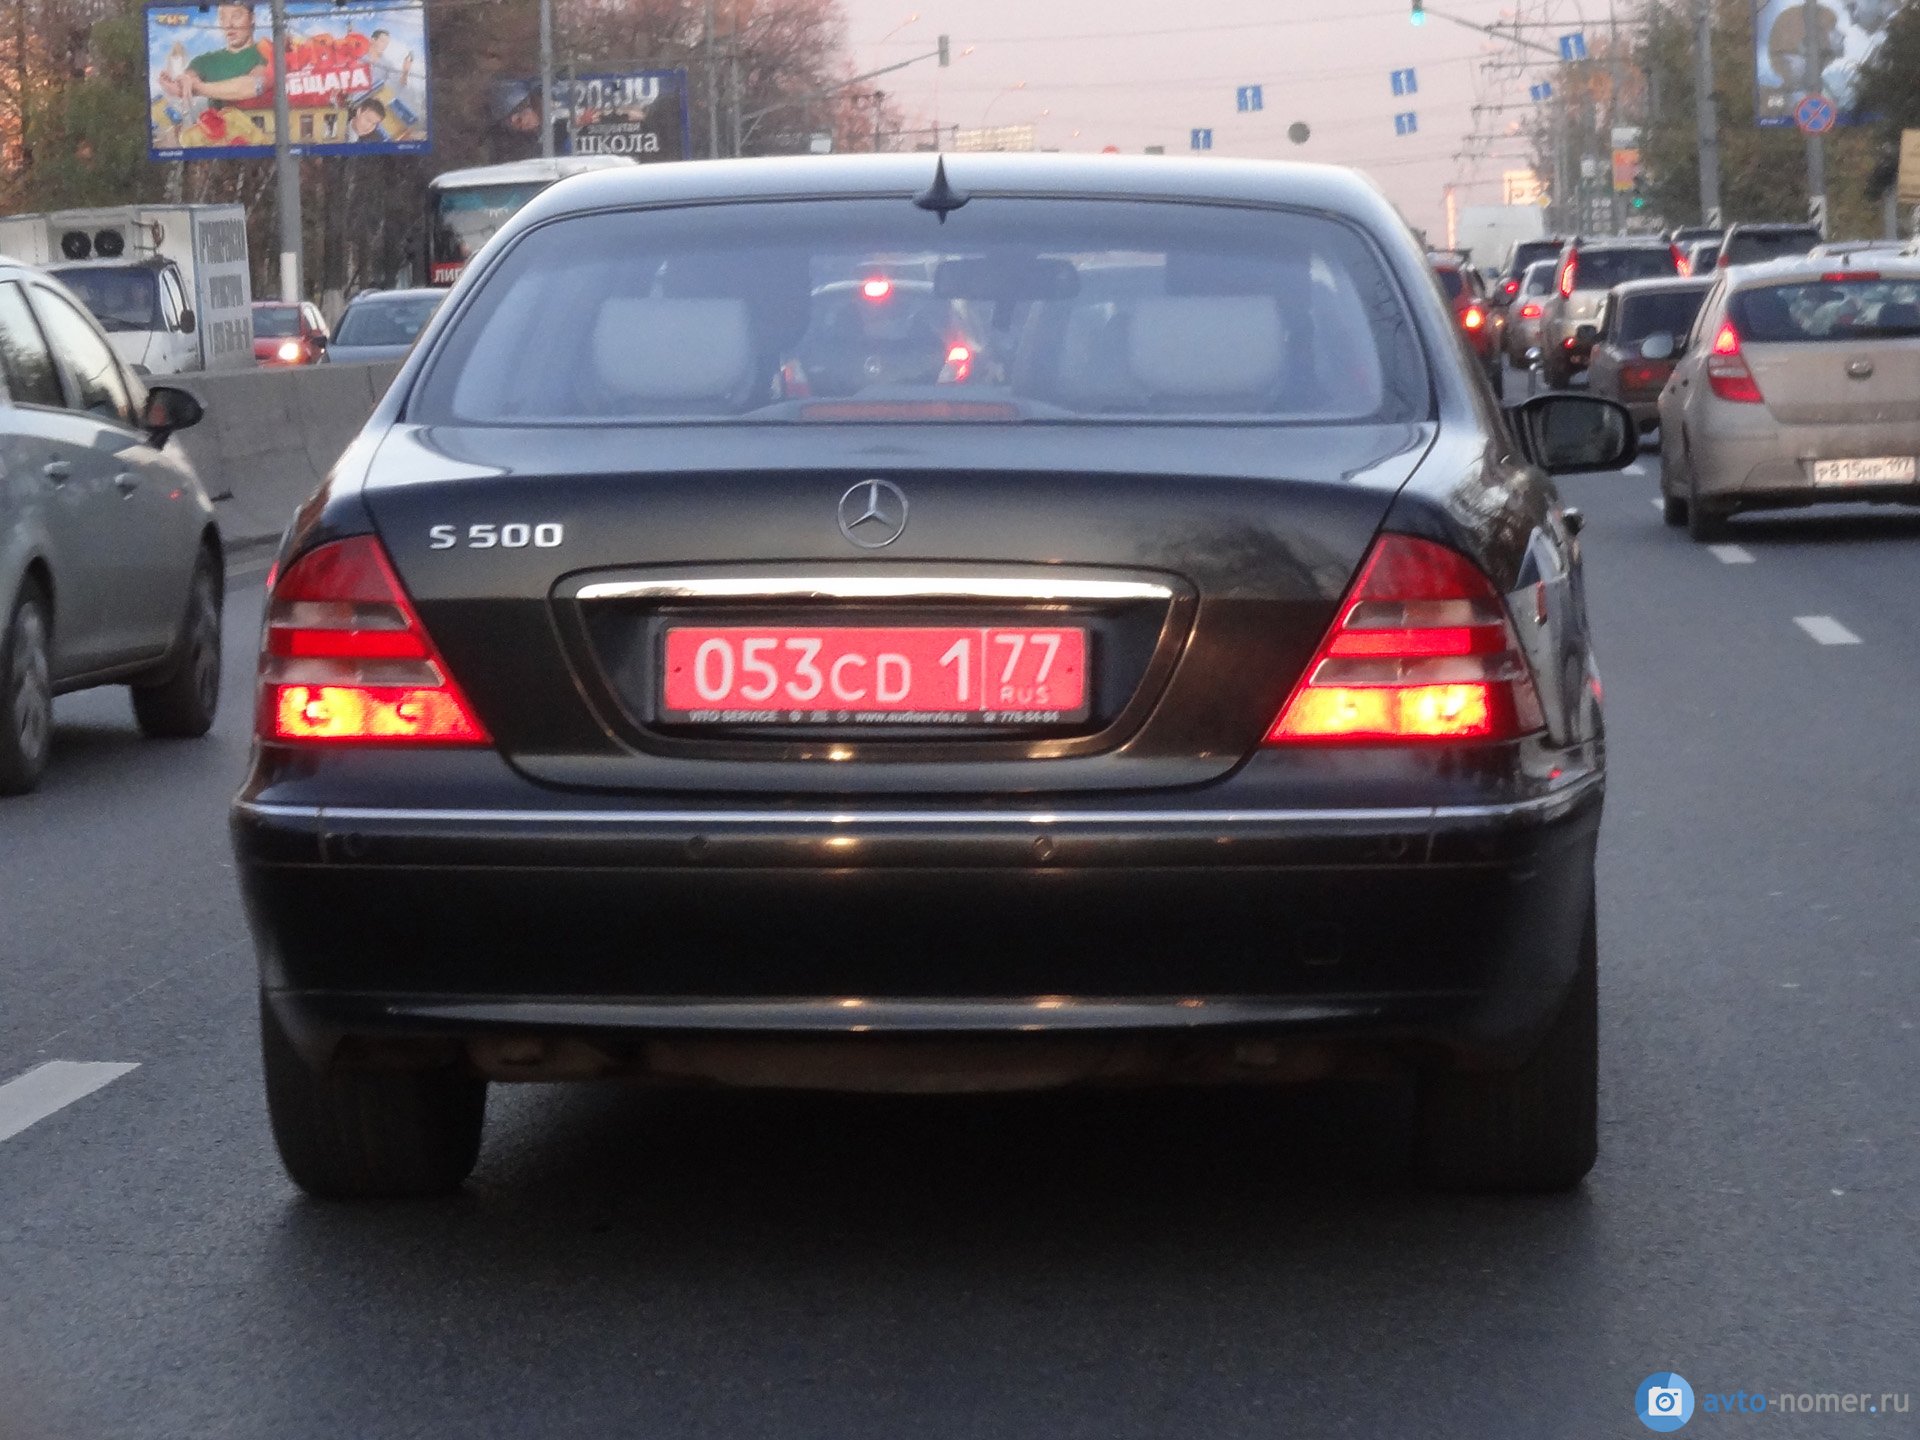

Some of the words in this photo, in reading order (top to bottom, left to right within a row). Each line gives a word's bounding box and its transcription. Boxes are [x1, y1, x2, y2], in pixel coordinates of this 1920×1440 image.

[285, 67, 370, 96] БЩАГА
[429, 524, 457, 549] S
[468, 523, 565, 548] 500
[994, 633, 1062, 684] 77
[1000, 686, 1050, 704] RUS
